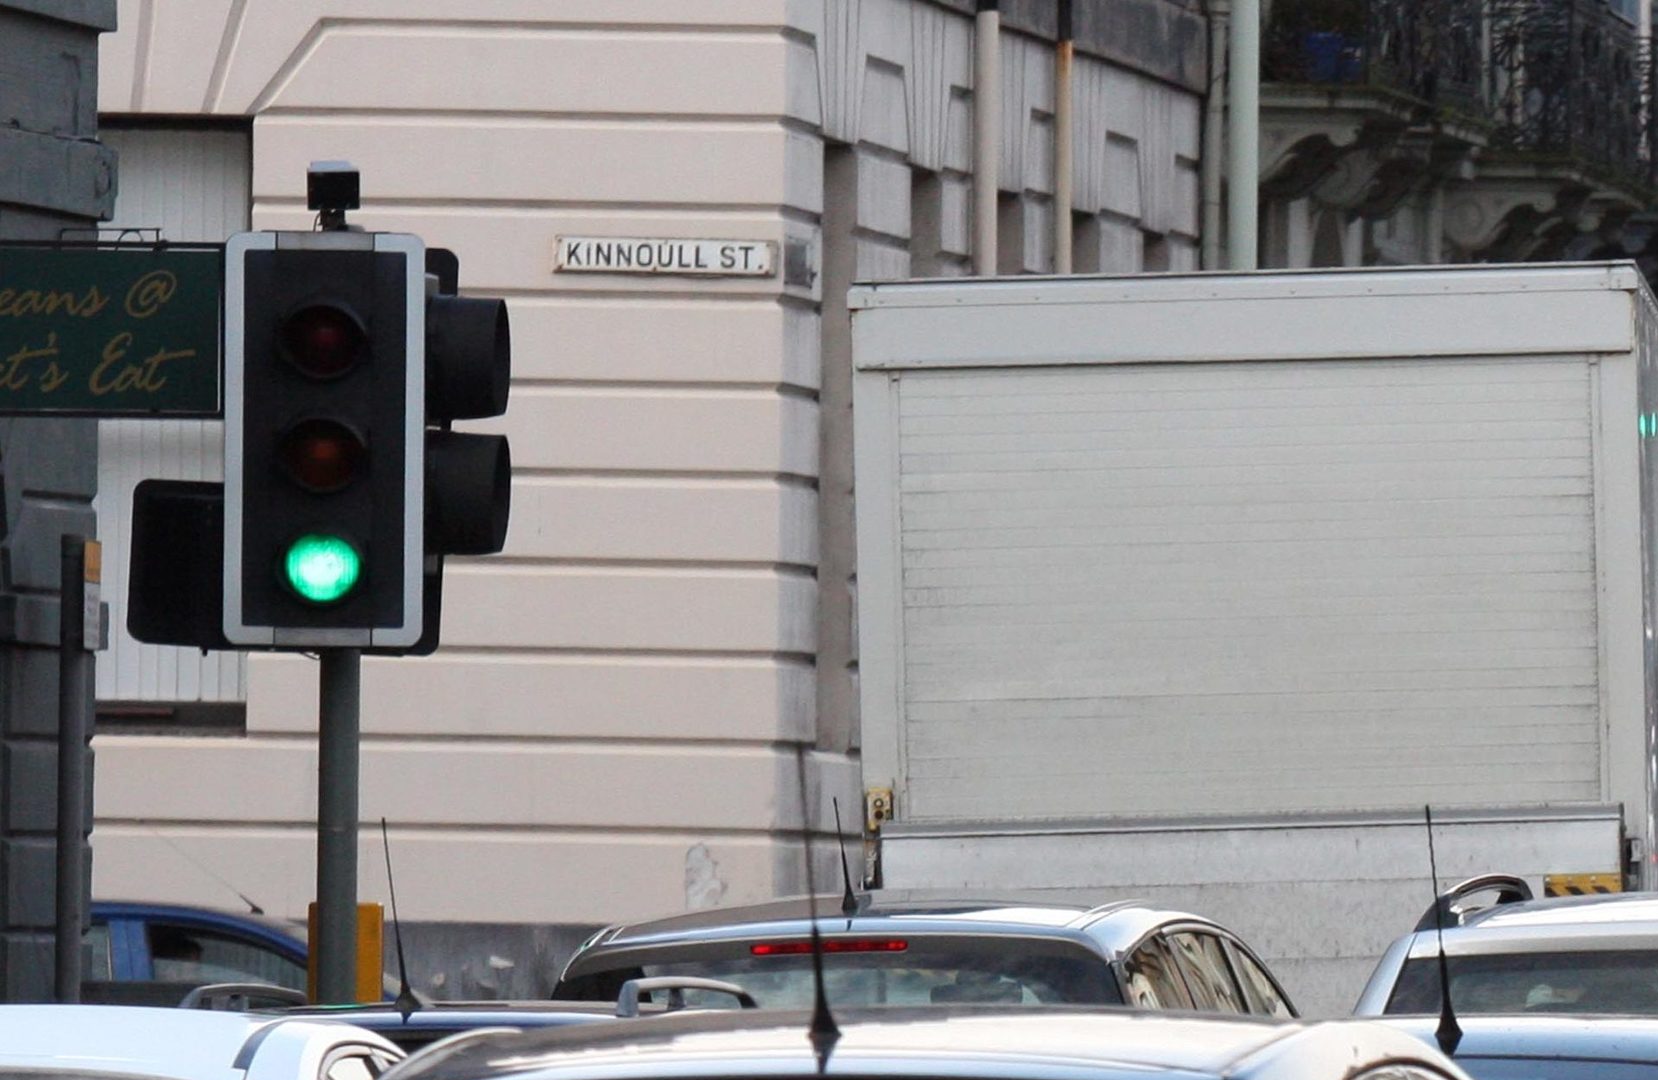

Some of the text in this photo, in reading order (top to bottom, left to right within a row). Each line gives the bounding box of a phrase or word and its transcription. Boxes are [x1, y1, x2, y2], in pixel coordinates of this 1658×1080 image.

[567, 243, 764, 270] KINNOULL ST.
[125, 270, 177, 318] @
[0, 332, 196, 396] t's Eat
